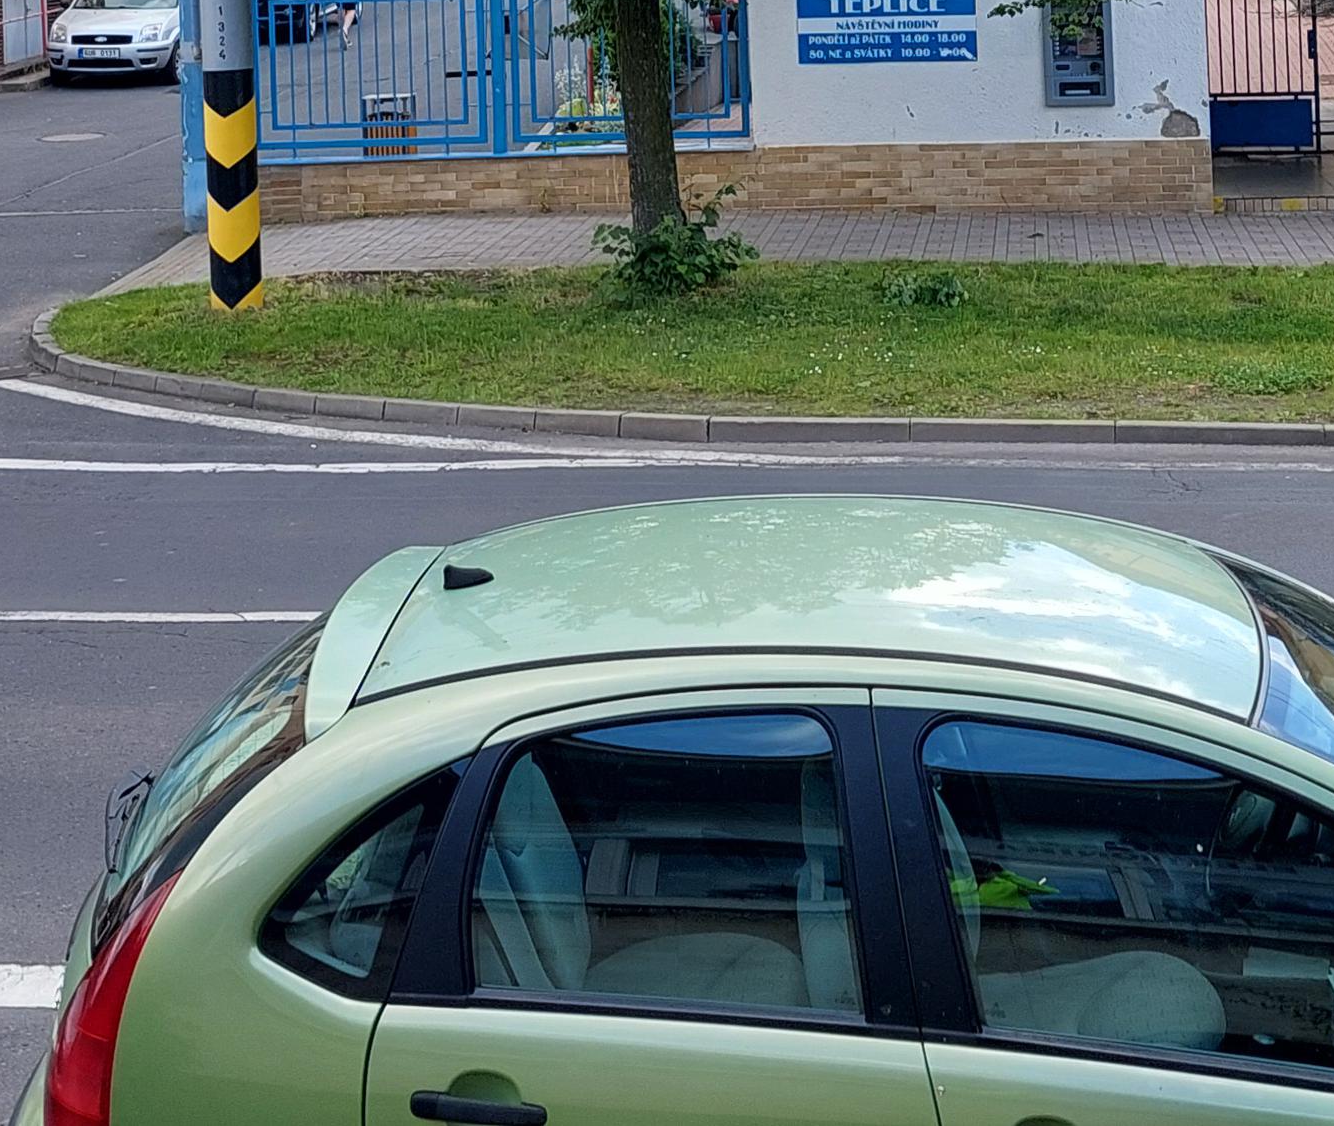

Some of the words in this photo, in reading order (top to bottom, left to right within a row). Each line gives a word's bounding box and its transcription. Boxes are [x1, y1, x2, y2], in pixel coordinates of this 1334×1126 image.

[898, 20, 940, 30] HODINY
[862, 32, 892, 44] PÁTEK
[901, 33, 929, 43] 14.00
[938, 33, 966, 43] 18.00
[854, 47, 893, 58] SVÁTKY
[901, 48, 931, 57] 10.00
